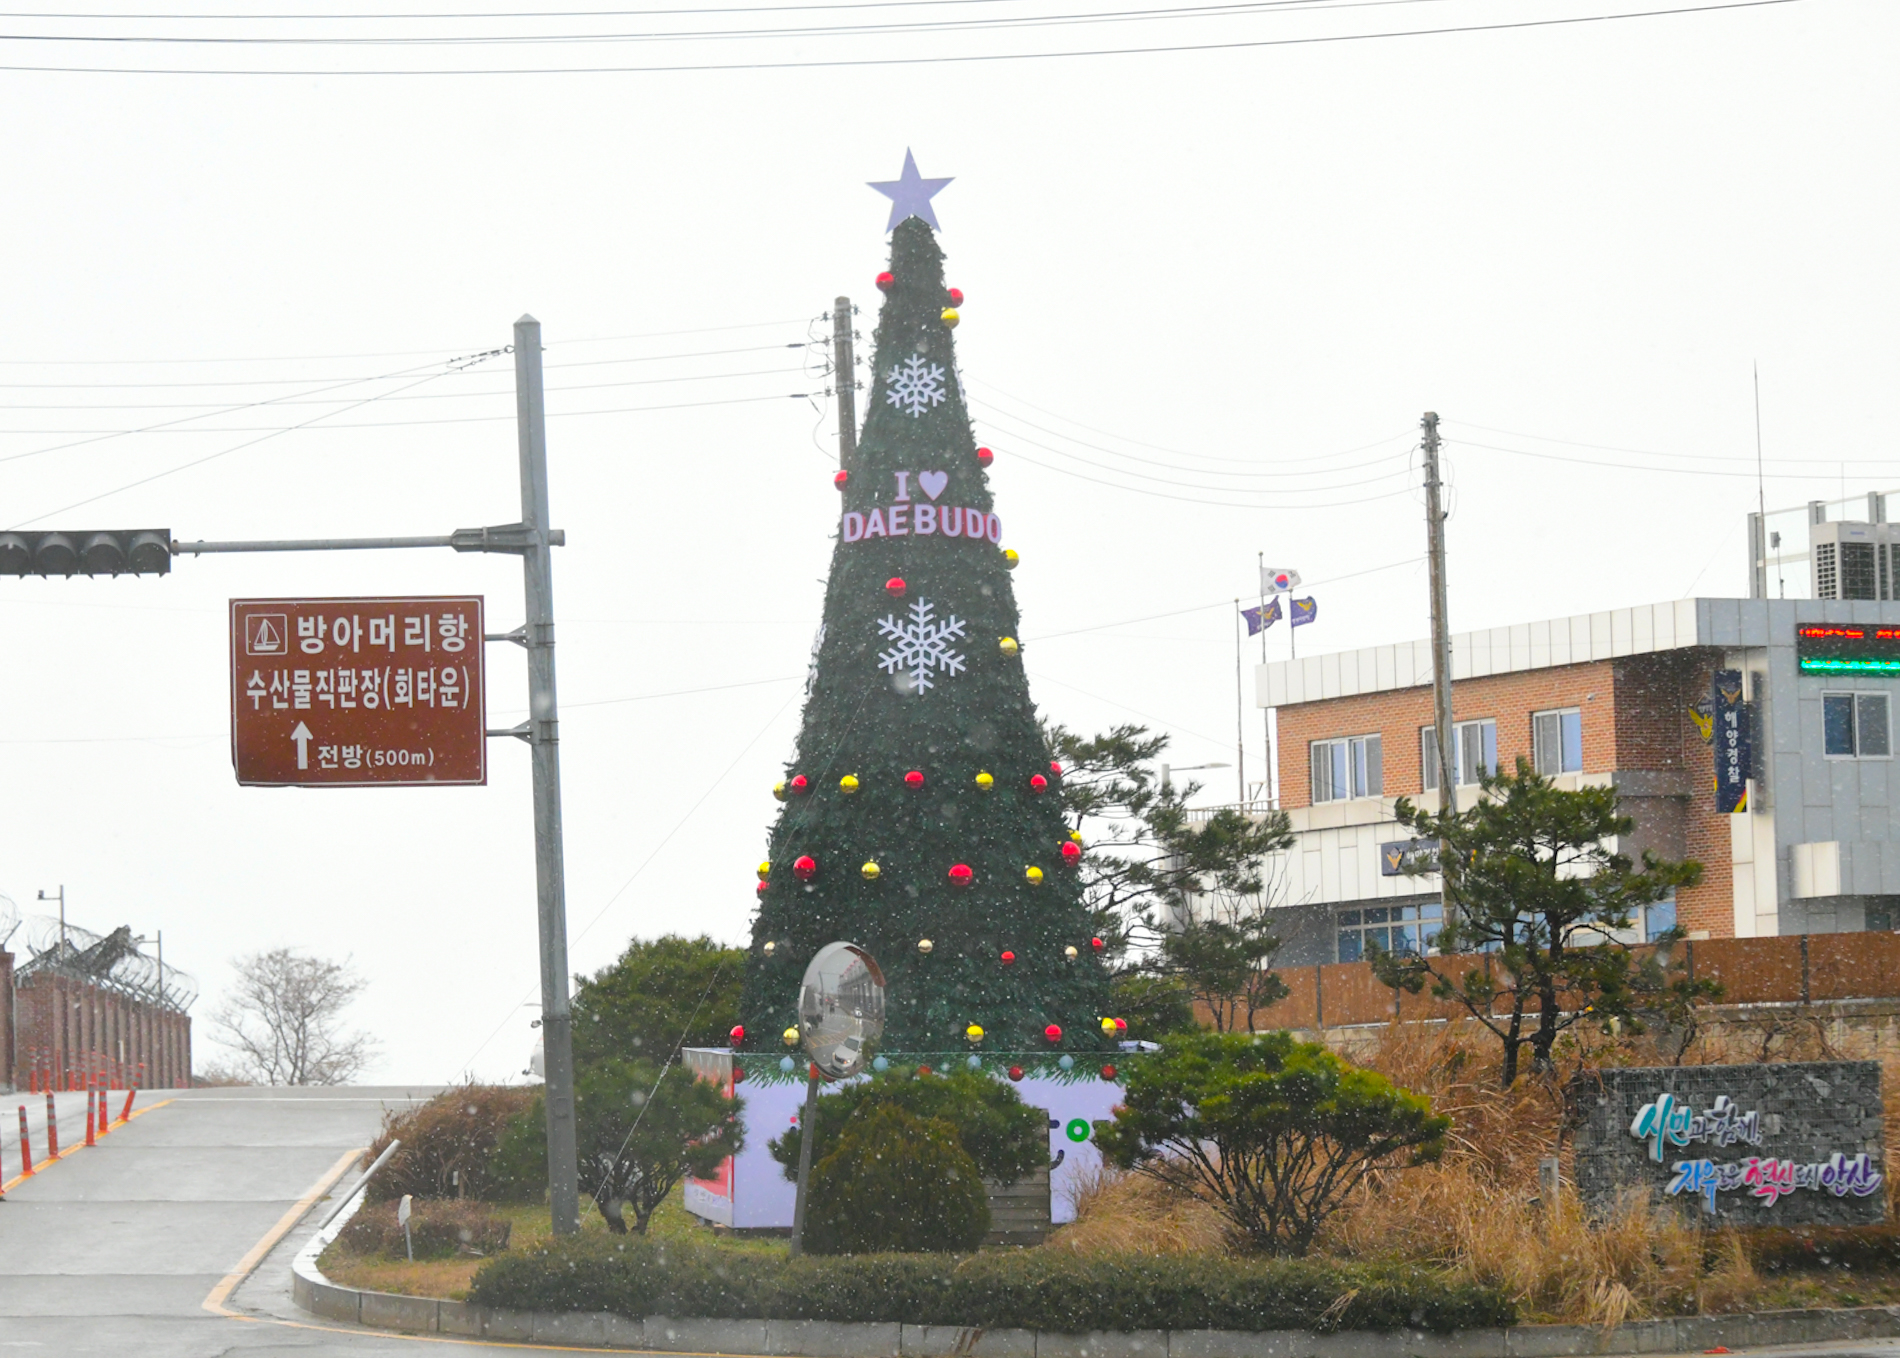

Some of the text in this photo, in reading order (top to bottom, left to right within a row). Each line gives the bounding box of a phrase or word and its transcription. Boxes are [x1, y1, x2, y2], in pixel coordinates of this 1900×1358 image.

[894, 471, 911, 501] I
[843, 503, 1002, 544] DAEBUDO
[297, 613, 469, 654] 방아머리항
[246, 666, 469, 710] 수산물직판장(회타운)
[318, 744, 434, 769] 전방(500m)
[1723, 711, 1740, 784] 해양경찰
[1632, 1093, 1712, 1163] 시민과
[1819, 1153, 1883, 1197] 안산
